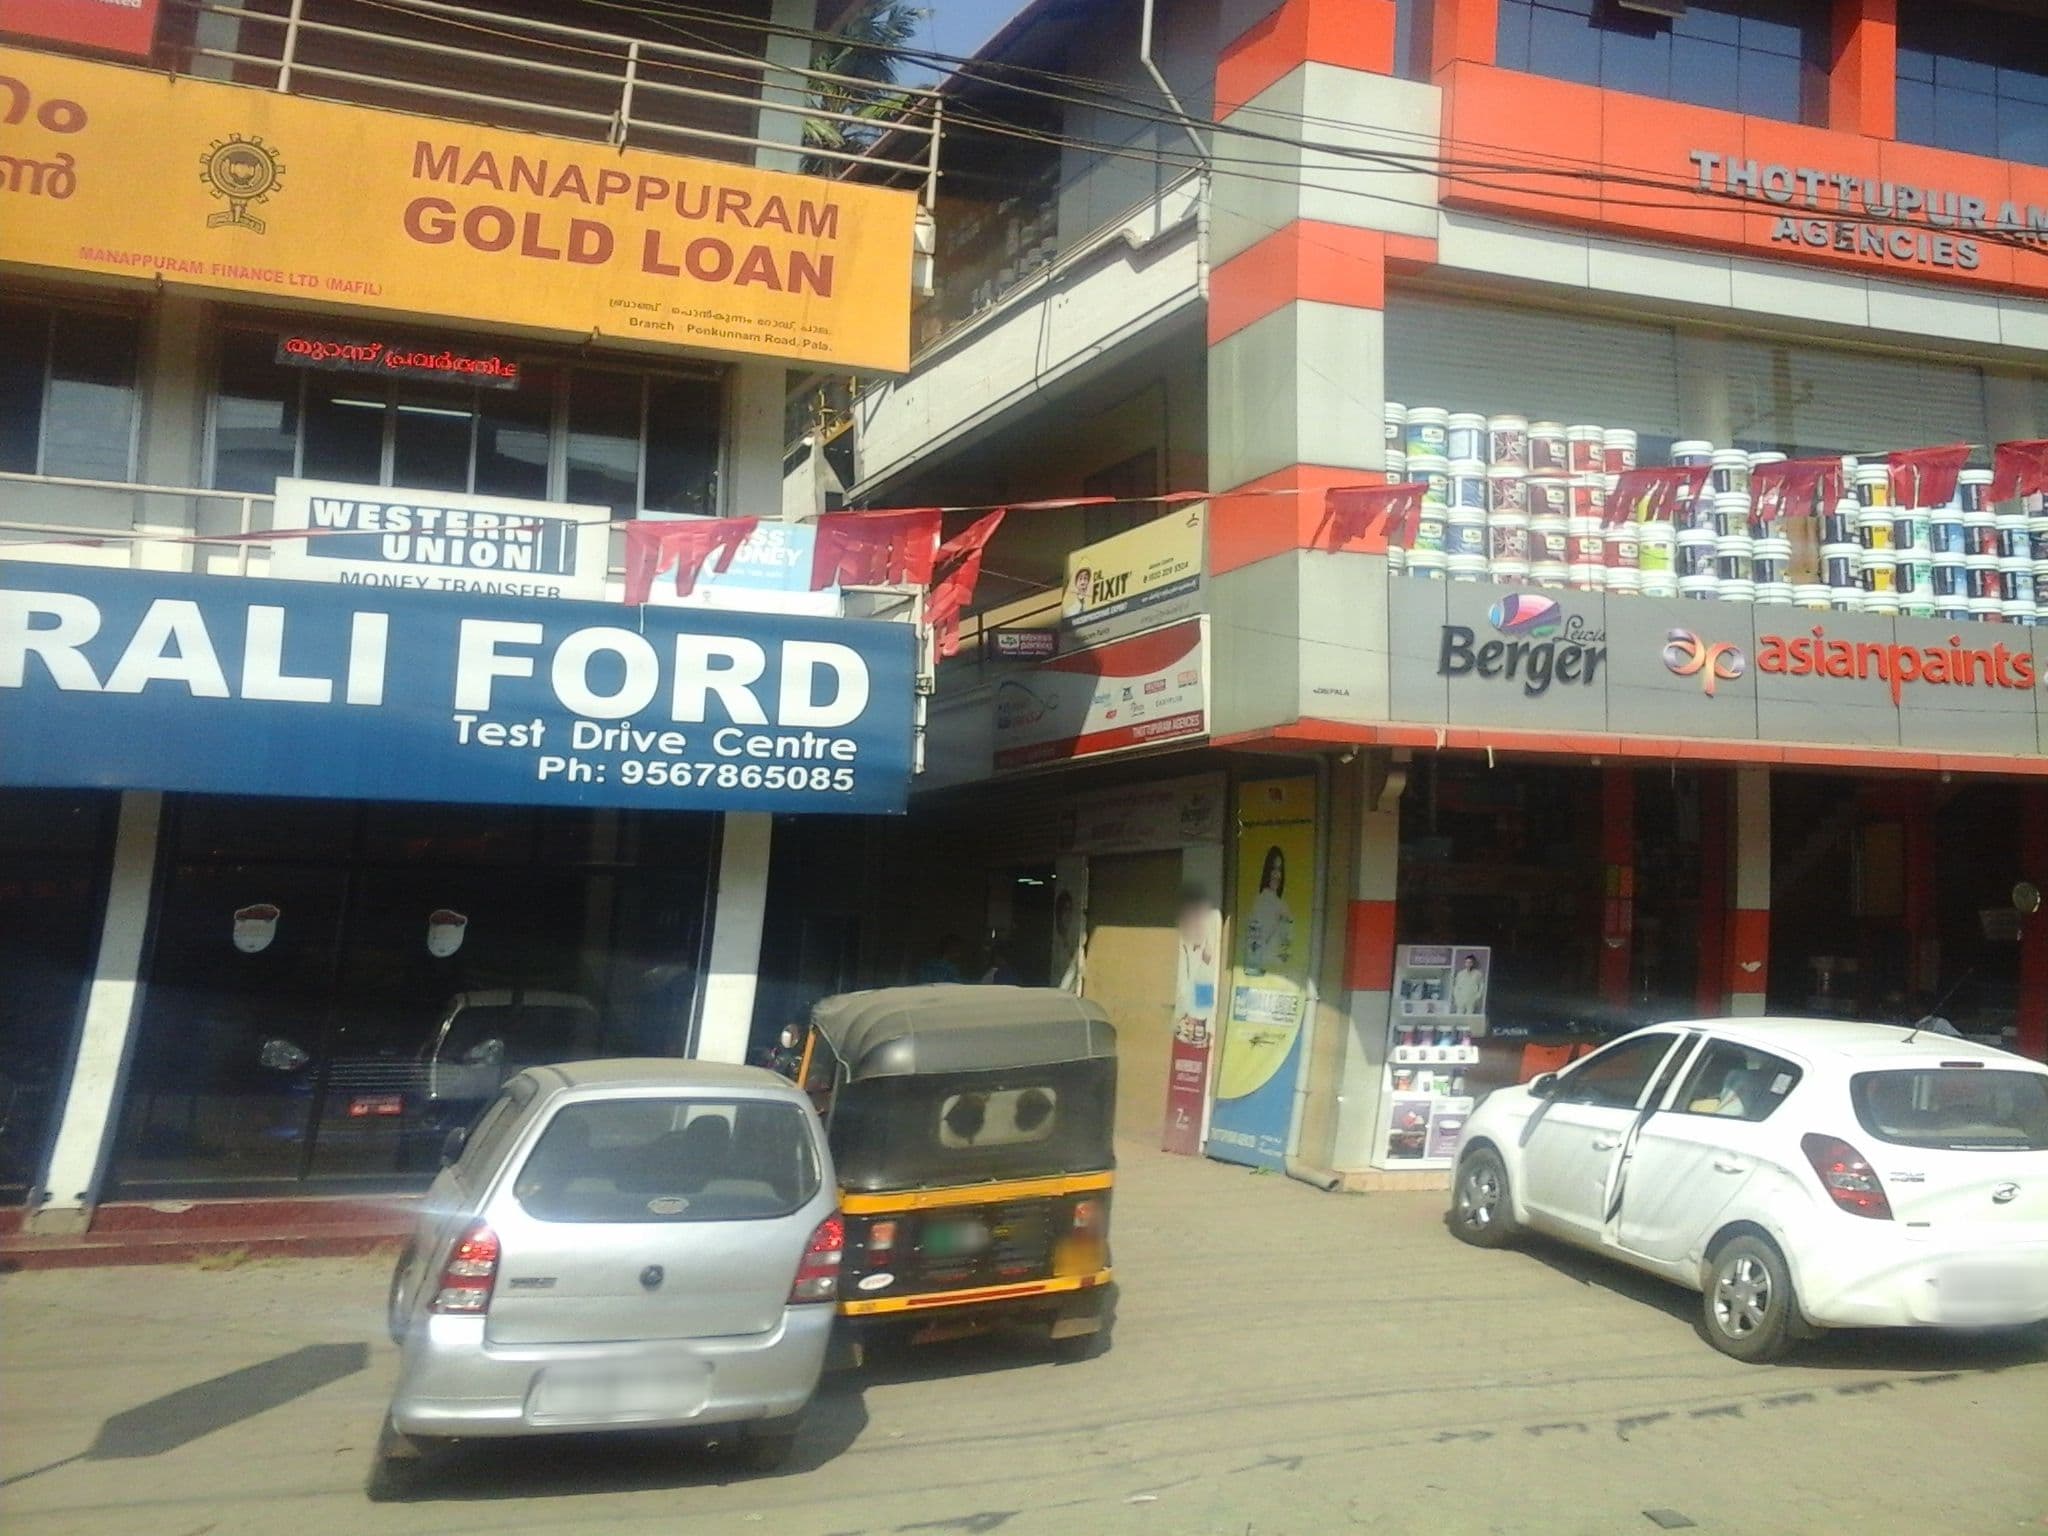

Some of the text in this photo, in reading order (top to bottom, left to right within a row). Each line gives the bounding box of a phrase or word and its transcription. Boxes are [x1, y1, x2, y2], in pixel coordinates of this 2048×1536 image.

[412, 140, 839, 241] MANAPPURAM
[403, 197, 834, 299] GOLD LOAN
[1771, 215, 1980, 270] AGENCIES
[79, 246, 383, 297] MANAPPURAM FINANCE LTD (MAFIL)
[629, 317, 675, 332] Branch
[687, 322, 761, 343] Ponkunnam
[313, 500, 536, 544] WESTERN
[382, 534, 533, 572] UNION
[1092, 571, 1130, 604] FIXIT
[0, 589, 872, 729] RALI FORD
[1438, 625, 1608, 697] Berger
[1757, 625, 2036, 707] asianpaints
[452, 714, 857, 761] Test Drive Centre
[538, 756, 855, 793] Ph: 9567865085
